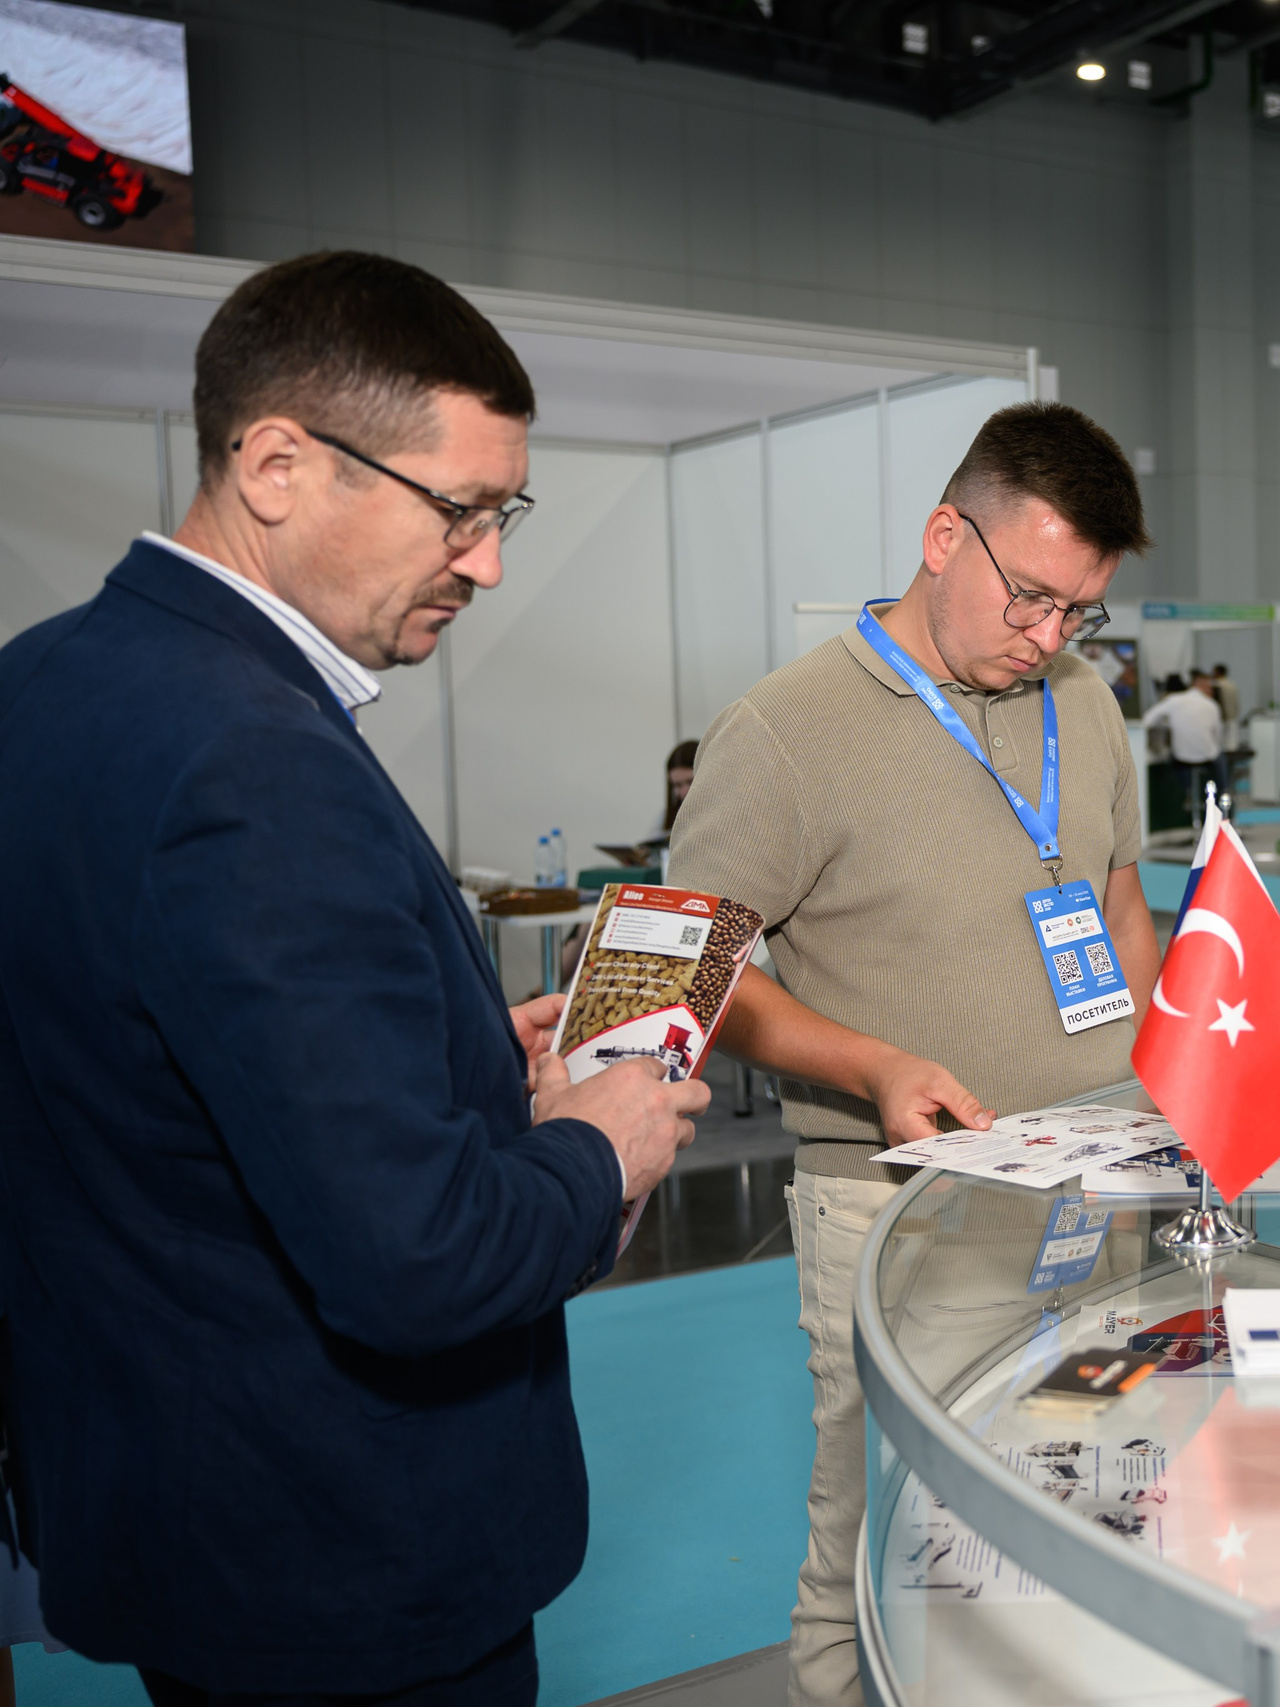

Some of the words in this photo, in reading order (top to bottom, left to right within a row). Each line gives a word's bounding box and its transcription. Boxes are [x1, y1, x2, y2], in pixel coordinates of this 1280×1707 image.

[646, 976, 675, 986] Services
[638, 988, 662, 998] Quality
[1066, 998, 1130, 1025] ПОСЕТИТЕЛЬ
[1104, 1310, 1117, 1335] MAYER
